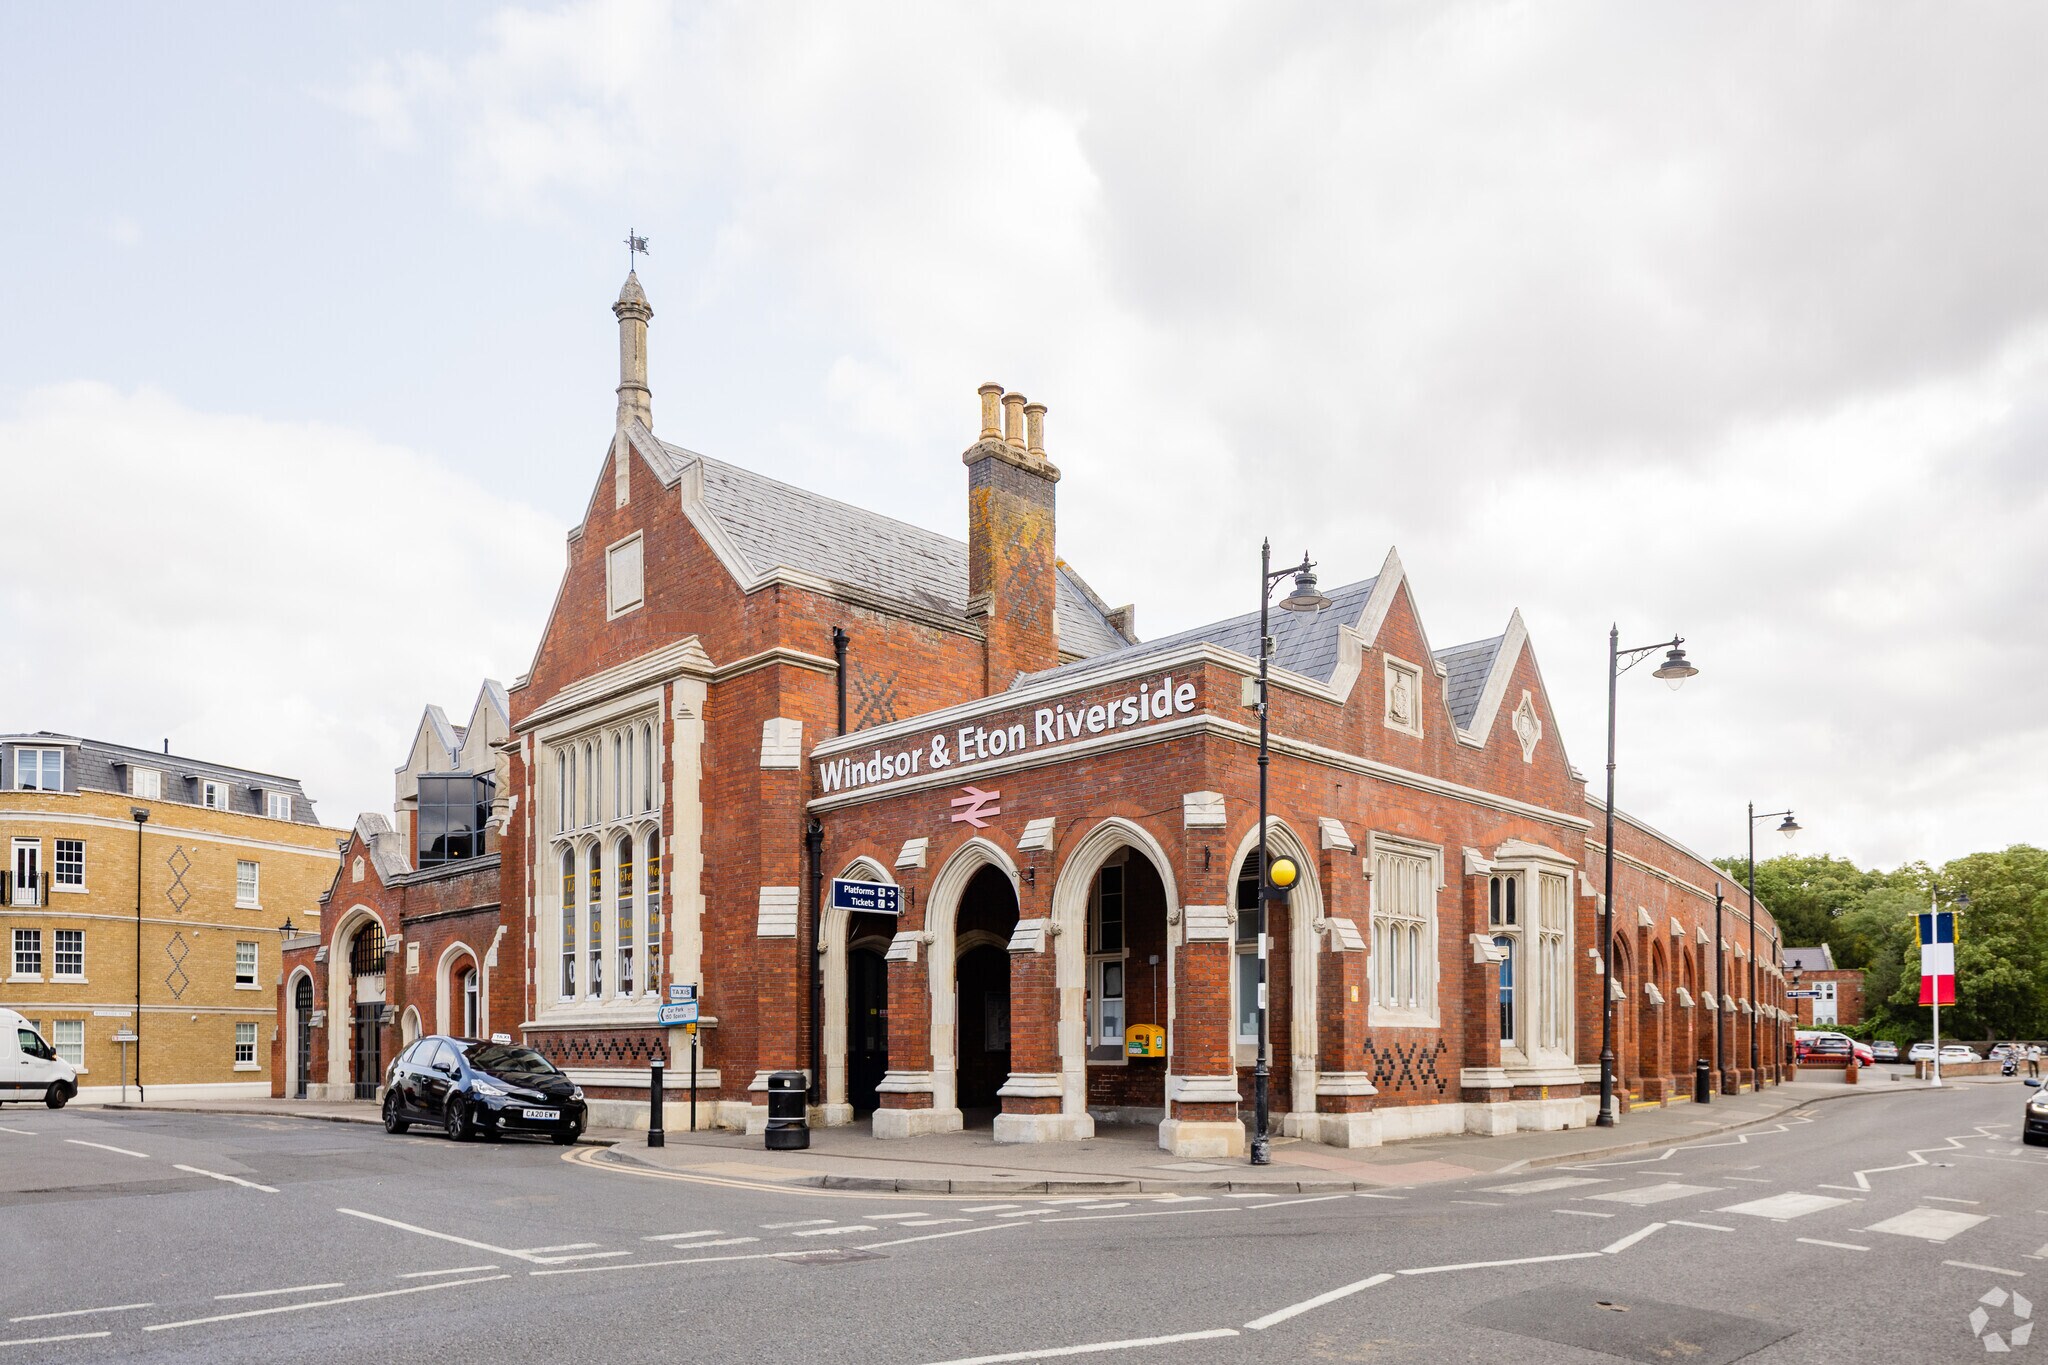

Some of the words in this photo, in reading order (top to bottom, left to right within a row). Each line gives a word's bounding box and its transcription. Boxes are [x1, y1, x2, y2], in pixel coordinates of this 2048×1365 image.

[820, 747, 923, 793] Windsor
[929, 734, 951, 769] &
[958, 724, 1027, 763] Eton
[1035, 677, 1197, 746] Riverside
[843, 885, 875, 896] Platforms
[851, 897, 875, 907] Tickets
[526, 1110, 544, 1118] CA20
